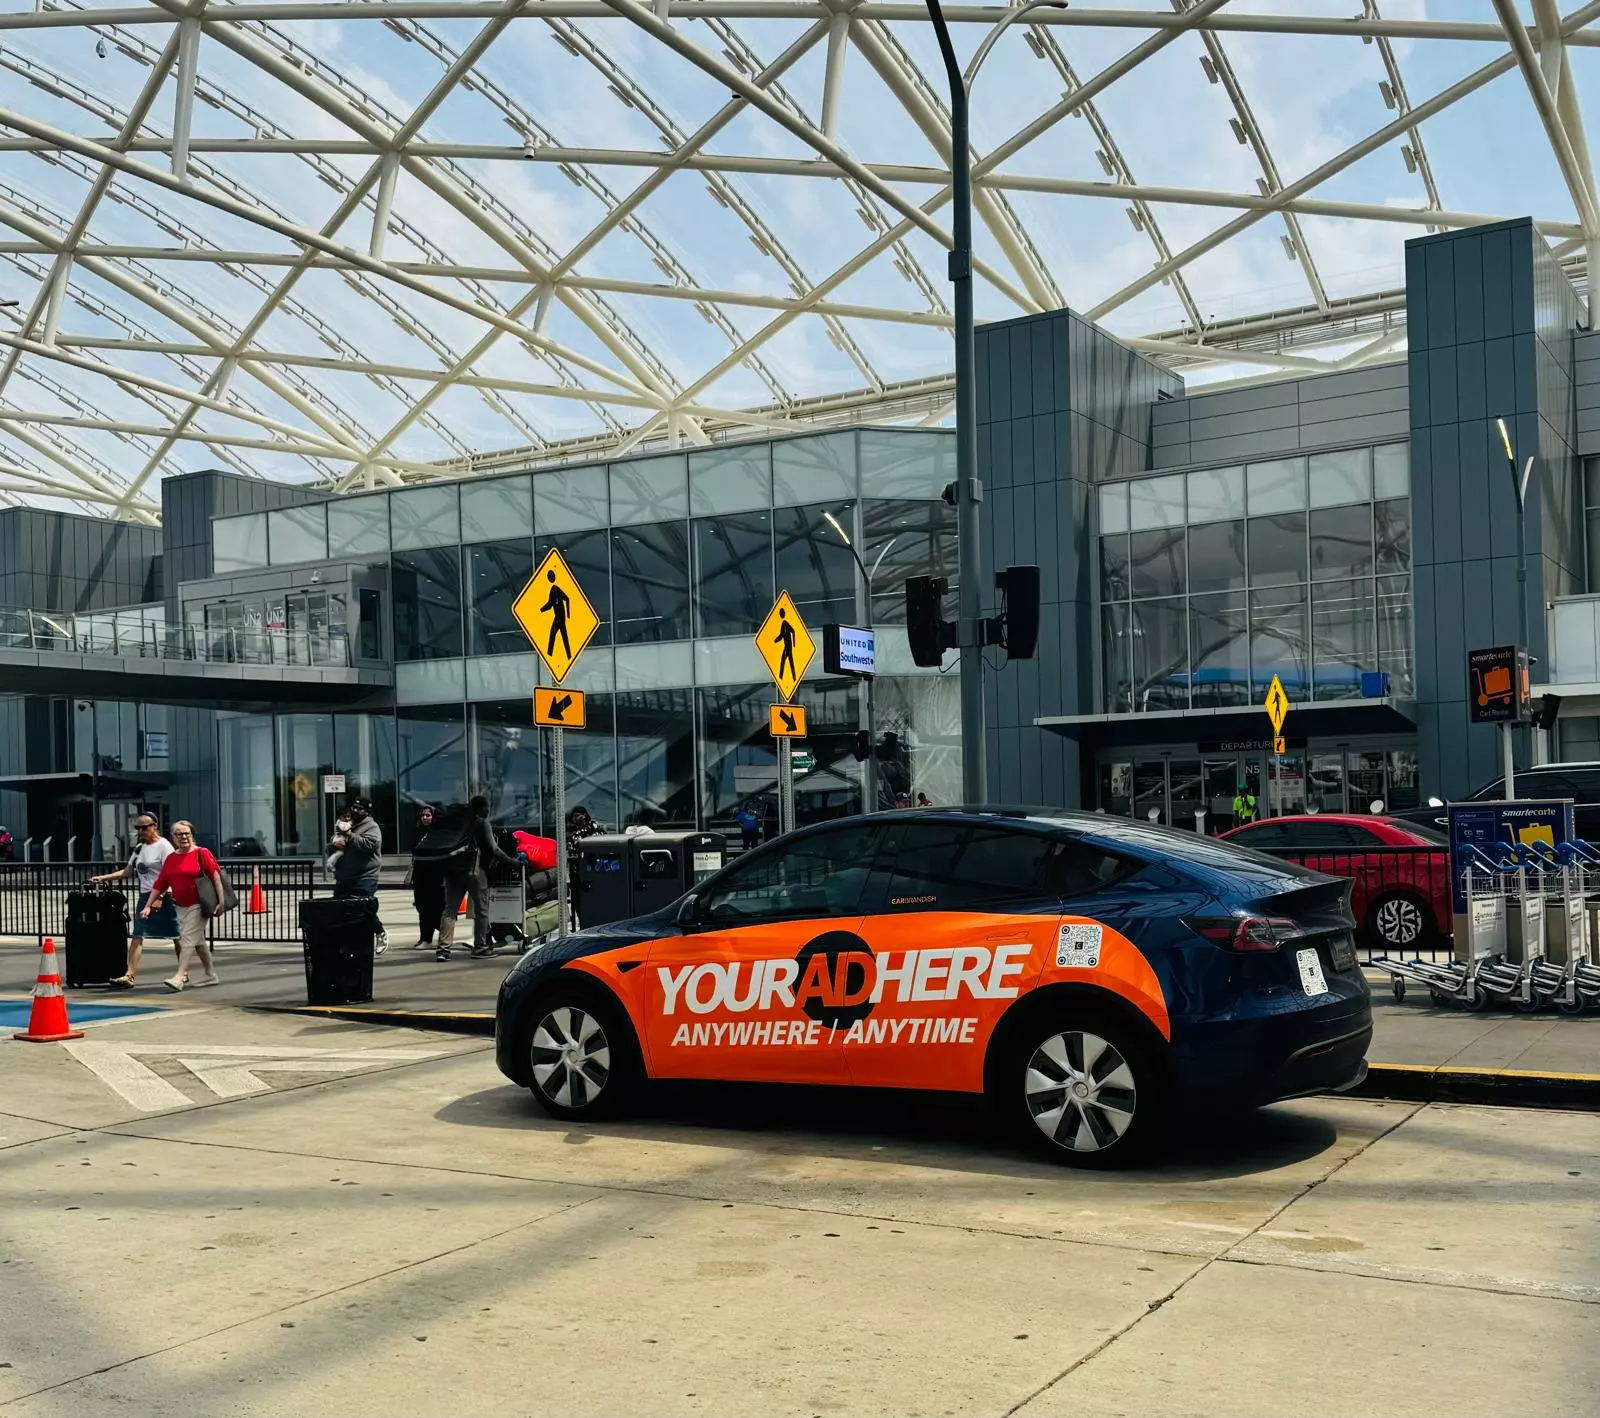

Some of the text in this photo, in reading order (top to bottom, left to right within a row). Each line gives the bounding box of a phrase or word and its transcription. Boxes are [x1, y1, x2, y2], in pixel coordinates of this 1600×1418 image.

[244, 612, 262, 625] UN2
[840, 638, 867, 649] UNITED
[840, 651, 871, 665] Southwest
[1220, 740, 1275, 751] DEPARTURE
[1501, 808, 1556, 818] smartecarte
[891, 895, 937, 905] CARBRANDISH
[670, 1019, 823, 1047] ANYWHERE
[842, 1017, 979, 1045] ANYTIME
